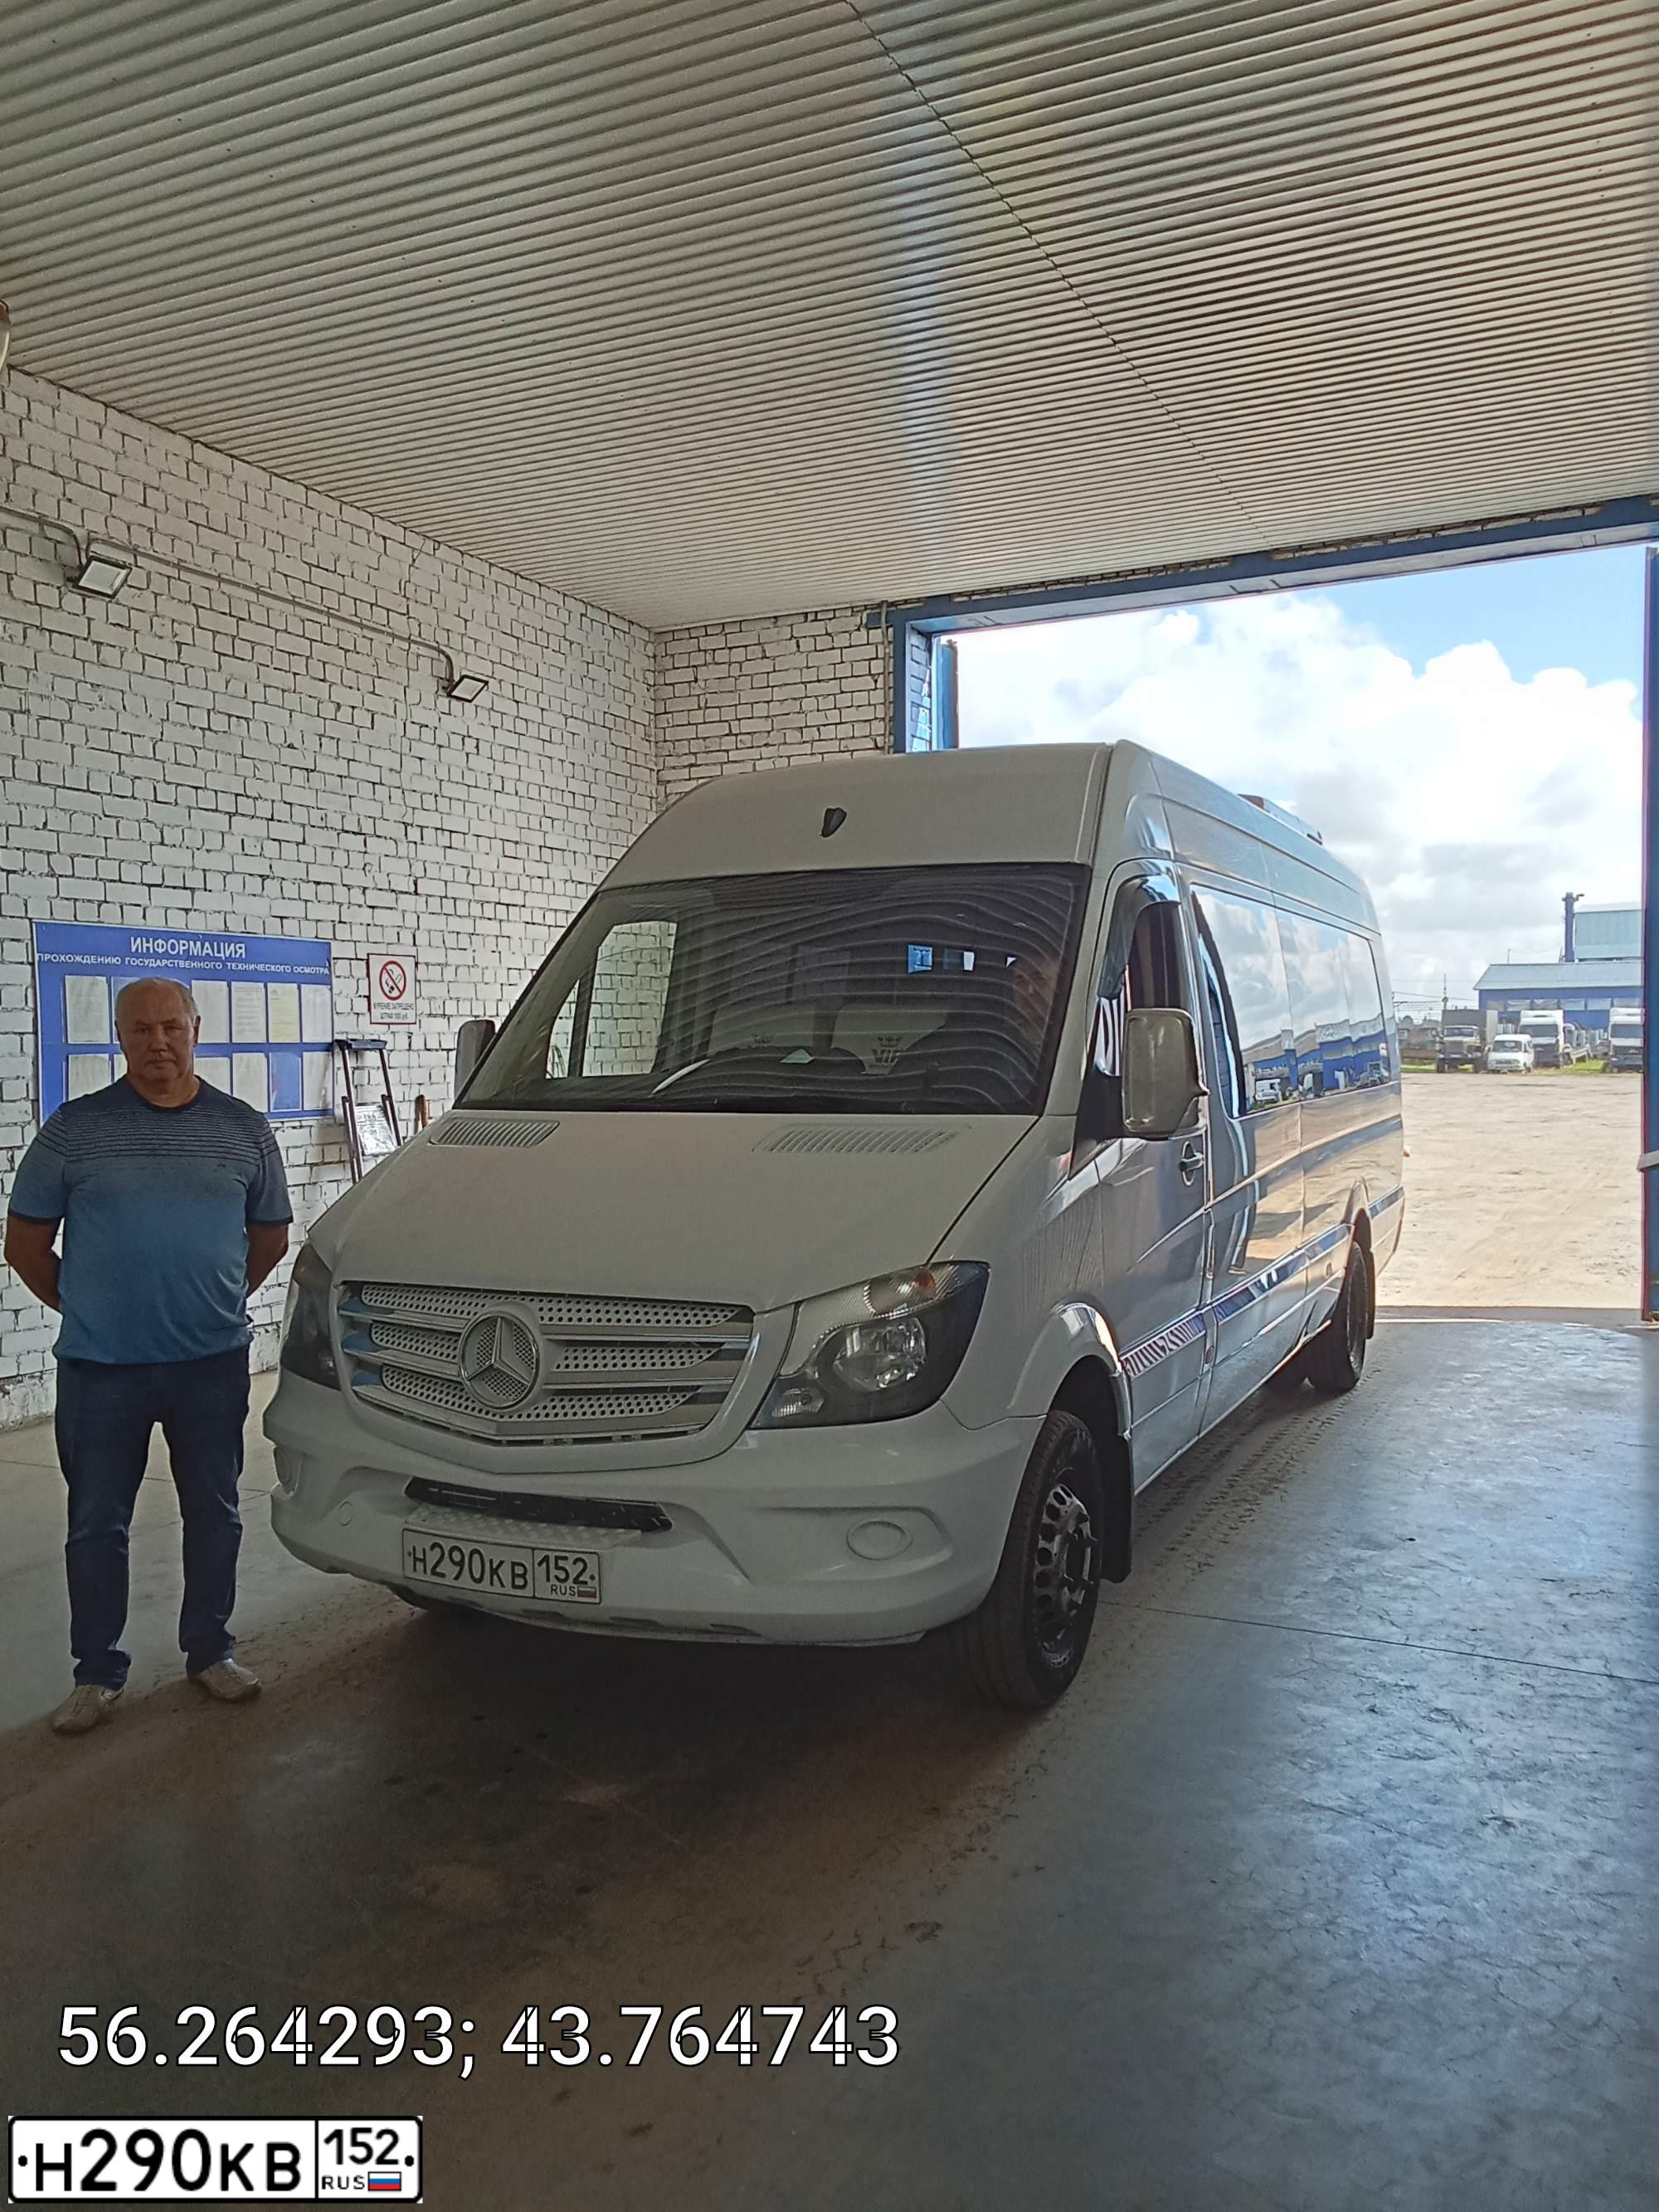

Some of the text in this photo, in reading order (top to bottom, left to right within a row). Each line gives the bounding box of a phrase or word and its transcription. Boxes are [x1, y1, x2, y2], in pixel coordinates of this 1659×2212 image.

[130, 936, 246, 960] ИНФОРМАЦИЯ
[36, 953, 329, 975] ПРОХОЖДЕНИЮ ГОСУДАРСТВЕННОГО ТЕХНИЧЕСКОГО ОСМОТРА
[538, 1554, 588, 1586] 152
[550, 1583, 577, 1596] RUS
